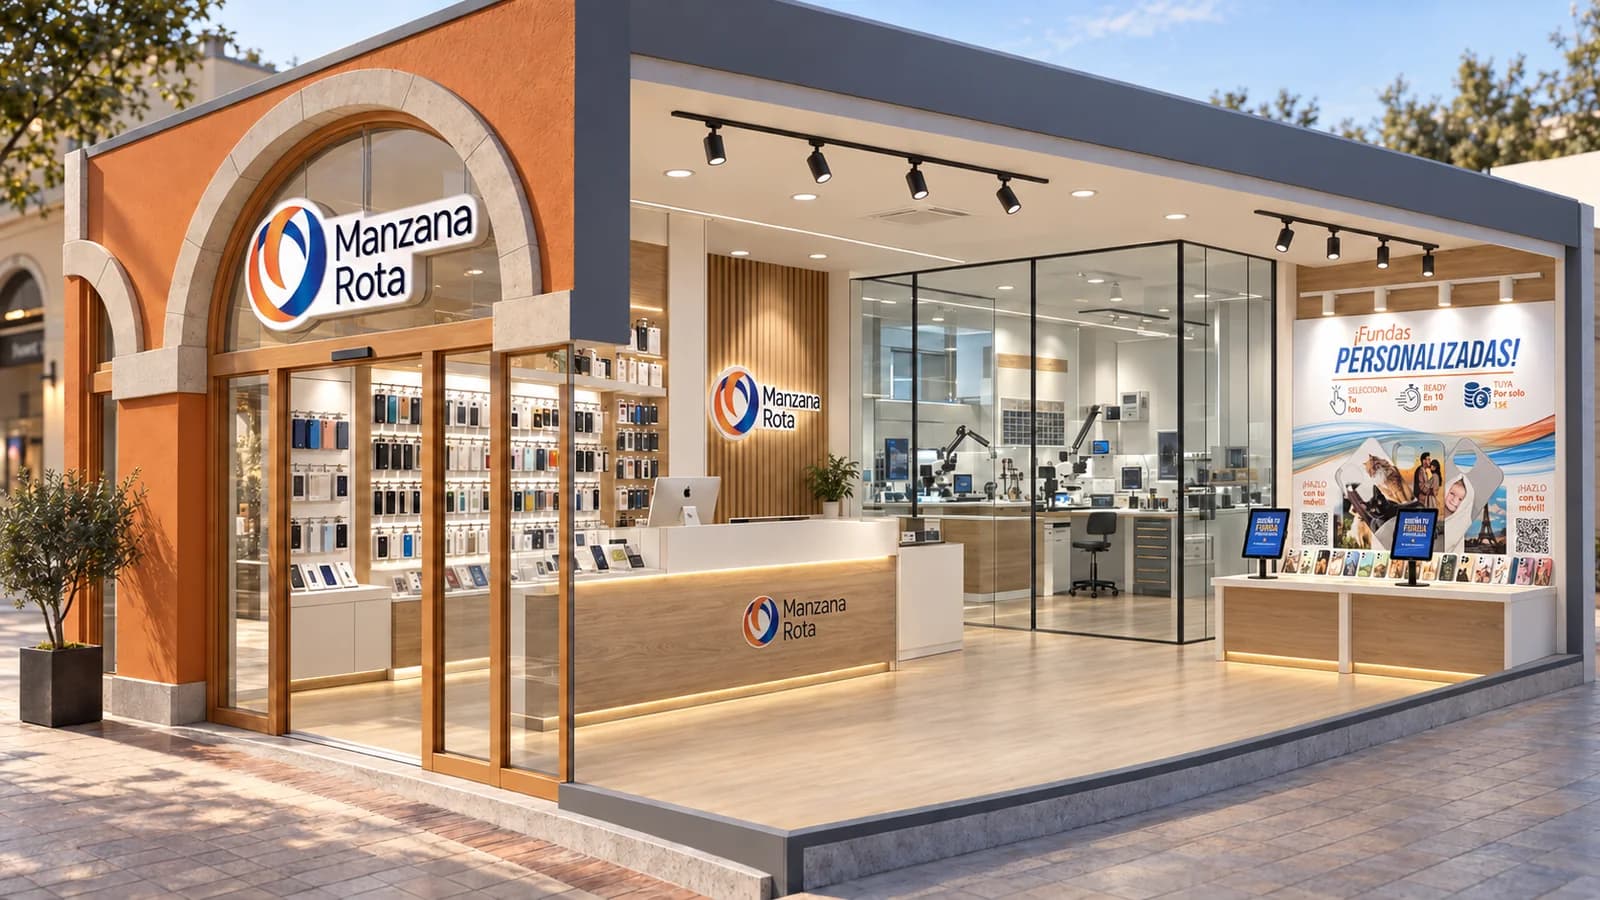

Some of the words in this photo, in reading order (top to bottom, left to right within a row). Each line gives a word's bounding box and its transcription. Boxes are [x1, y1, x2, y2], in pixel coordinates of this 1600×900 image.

[335, 205, 473, 262] Manzana
[335, 262, 405, 305] Rota
[1353, 323, 1411, 346] ¡Fundas
[1335, 338, 1521, 374] PERSONALIZADAS!
[1423, 383, 1447, 392] READY
[1493, 380, 1513, 388] TUYA
[1493, 390, 1507, 398] Por
[1508, 389, 1525, 397] solo
[763, 385, 820, 410] Manzana
[1423, 393, 1433, 401] En
[1435, 393, 1444, 401] 10
[1348, 405, 1363, 414] foto
[1423, 403, 1438, 412] min
[763, 408, 795, 429] Rota
[1518, 494, 1534, 502] con
[1535, 494, 1545, 502] tu
[783, 598, 847, 618] Manzana
[783, 620, 816, 641] Rota
